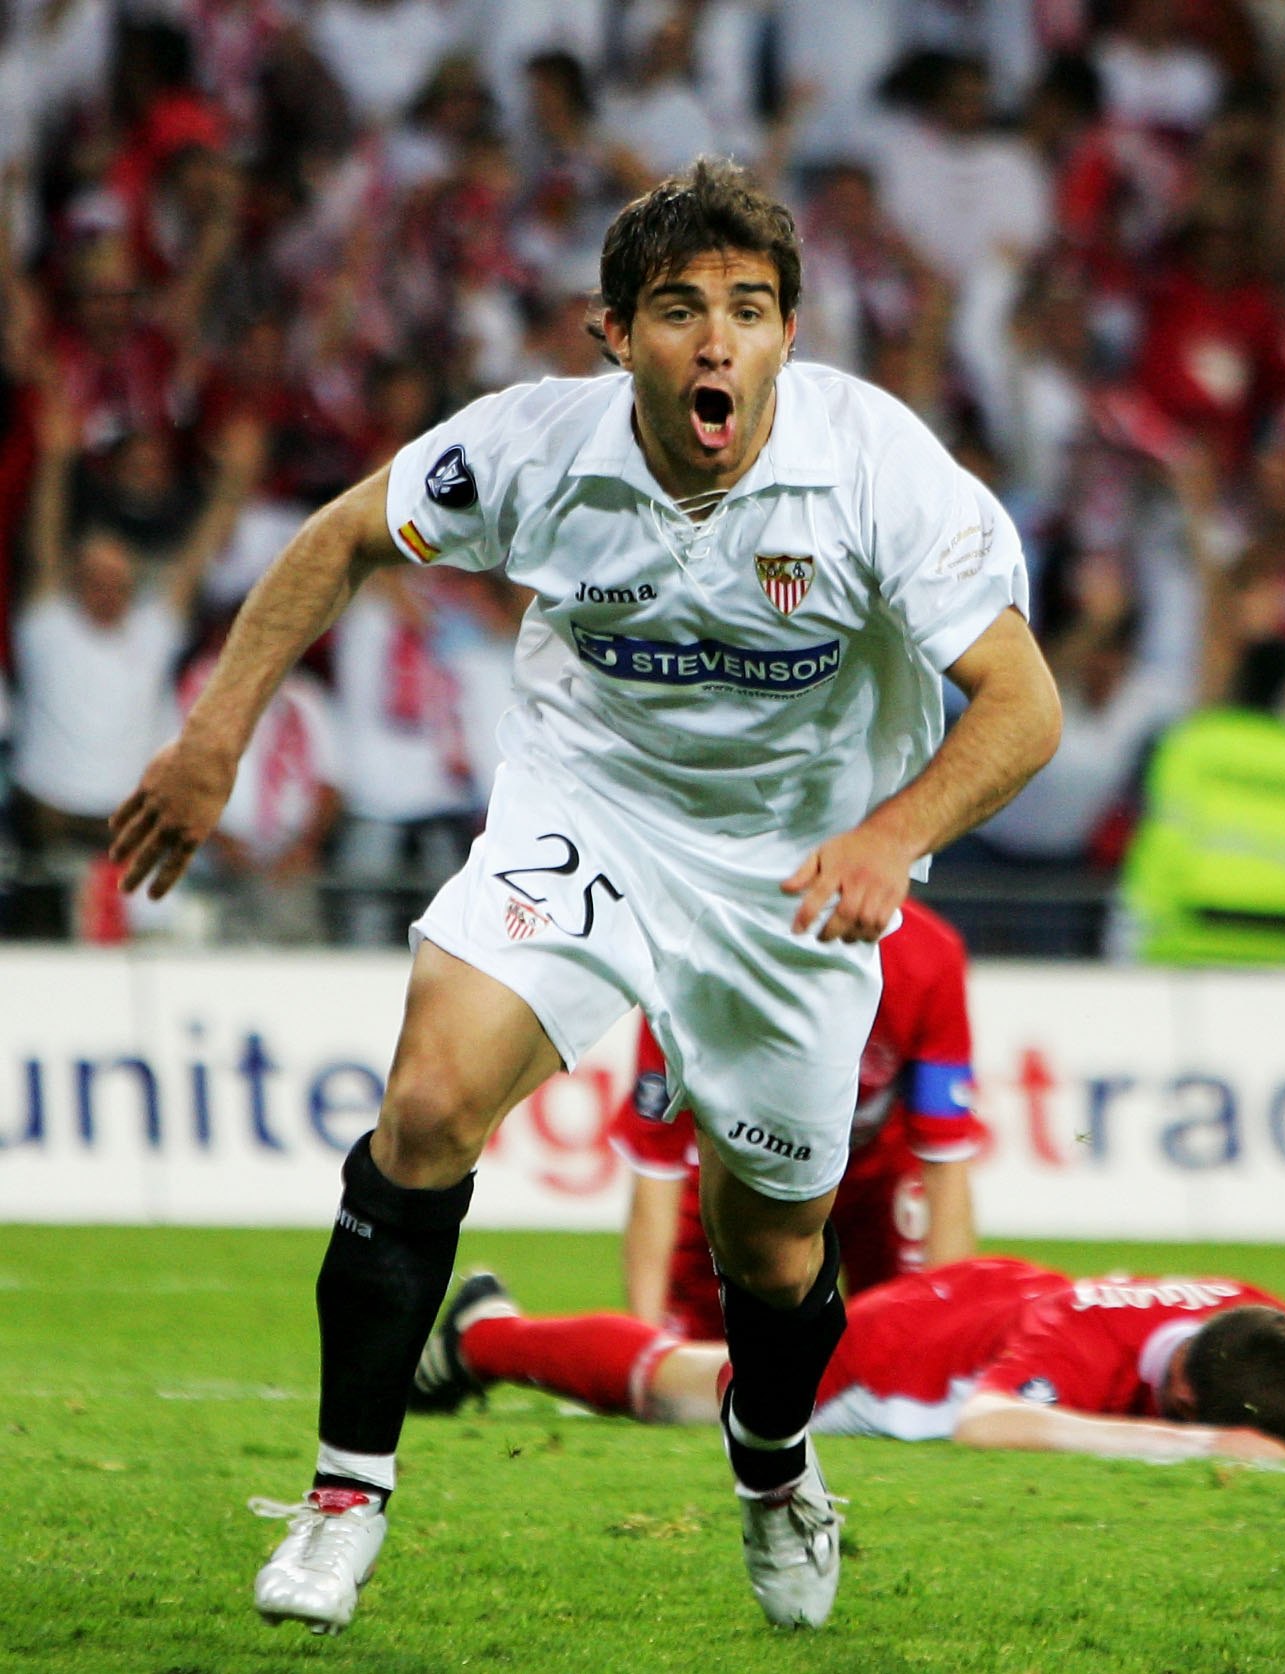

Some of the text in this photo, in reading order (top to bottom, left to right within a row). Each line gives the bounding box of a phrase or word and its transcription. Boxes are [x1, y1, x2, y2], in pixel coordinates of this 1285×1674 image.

[575, 580, 657, 604] Joma
[631, 650, 839, 682] STEVENSON
[492, 833, 625, 940] 25
[727, 1120, 813, 1162] Joma
